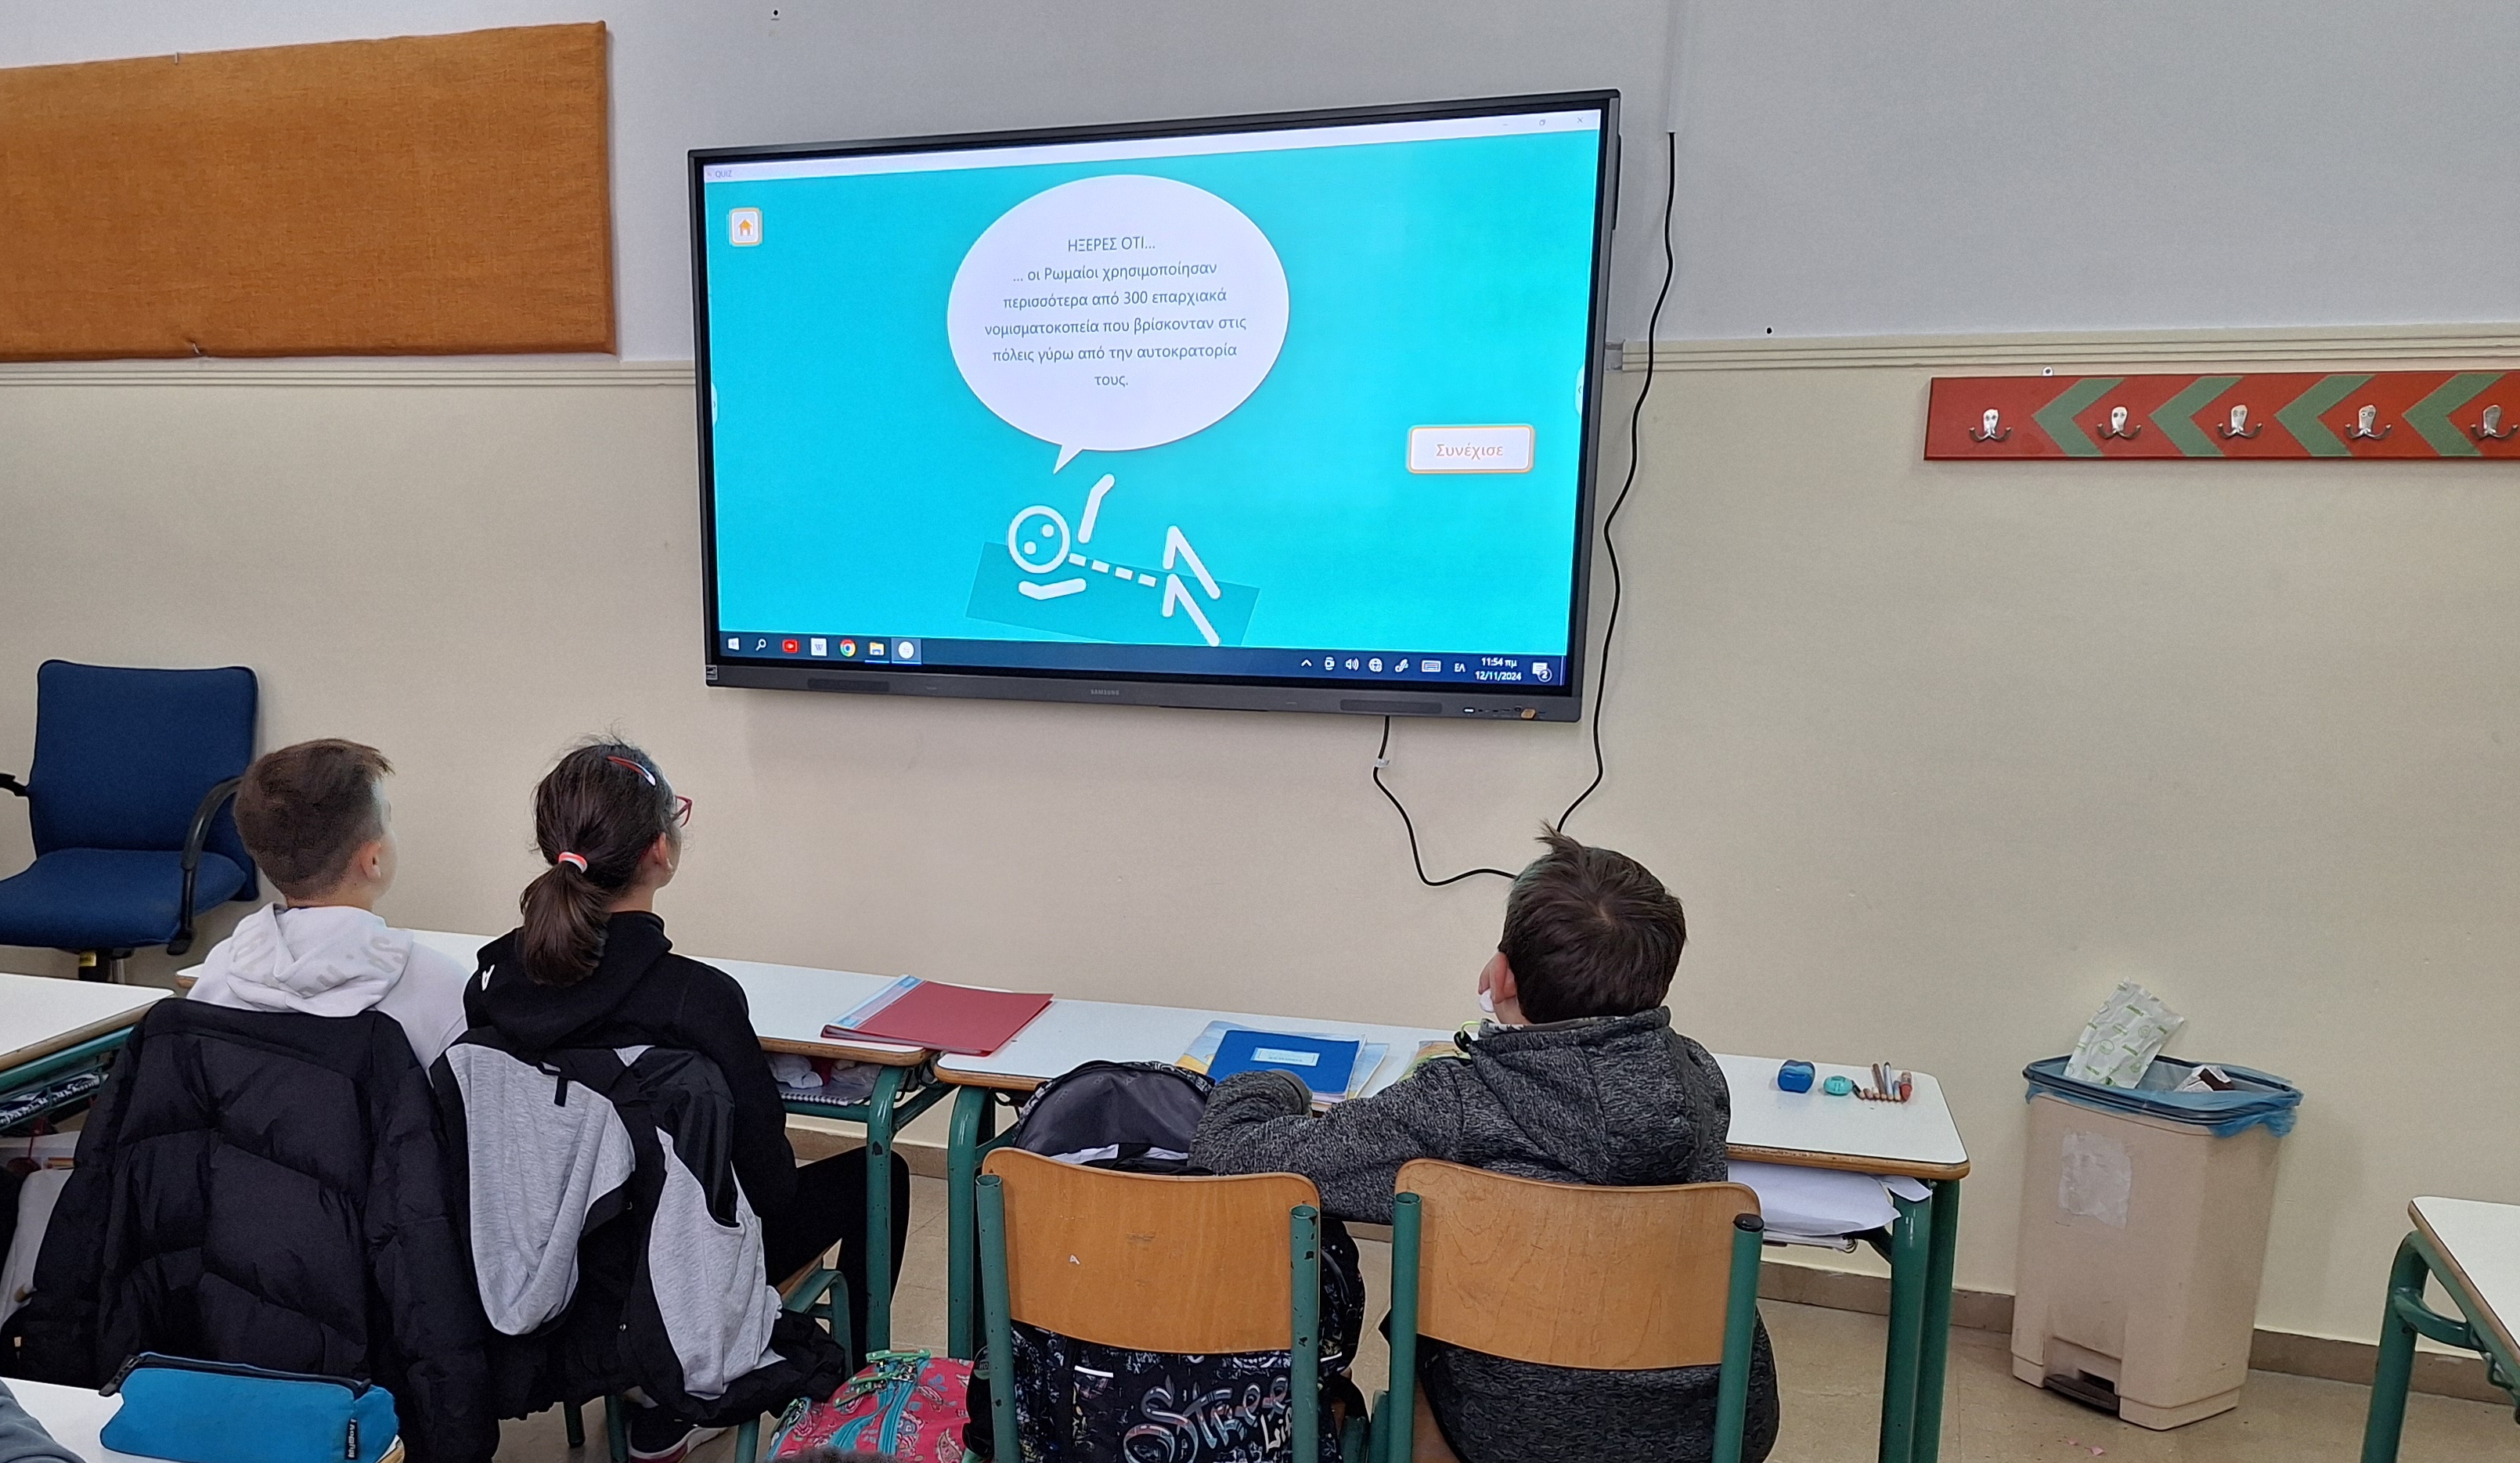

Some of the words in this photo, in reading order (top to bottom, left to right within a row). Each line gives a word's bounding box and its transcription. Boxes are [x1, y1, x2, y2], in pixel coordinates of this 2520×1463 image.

[1068, 237, 1117, 253] ΗΞΕΡΕΣ
[1027, 270, 1040, 281] οι
[1044, 267, 1098, 283] Ρωμαίοι
[1101, 261, 1217, 281] χρησιμοποίησαν
[1004, 294, 1088, 311] περισσότερα
[1092, 291, 1119, 308] από
[1123, 290, 1148, 304] 300
[1152, 287, 1227, 307] επαρχιακά
[985, 319, 1099, 338] νομισματοκοπεία
[1103, 321, 1130, 333] που
[1134, 317, 1213, 335] βρίσκονταν
[1218, 317, 1246, 331] στις
[993, 348, 1034, 362] πόλεις
[1038, 346, 1074, 363] γύρω
[1077, 345, 1105, 362] από
[1109, 346, 1133, 361] την
[1137, 343, 1237, 359] αυτοκρατορία
[1094, 373, 1128, 387] τους.
[1436, 442, 1503, 460] Συνέχισε
[1481, 658, 1503, 666] 11:54
[1505, 659, 1517, 668] πμ
[1475, 671, 1522, 681] 12/11/2024
